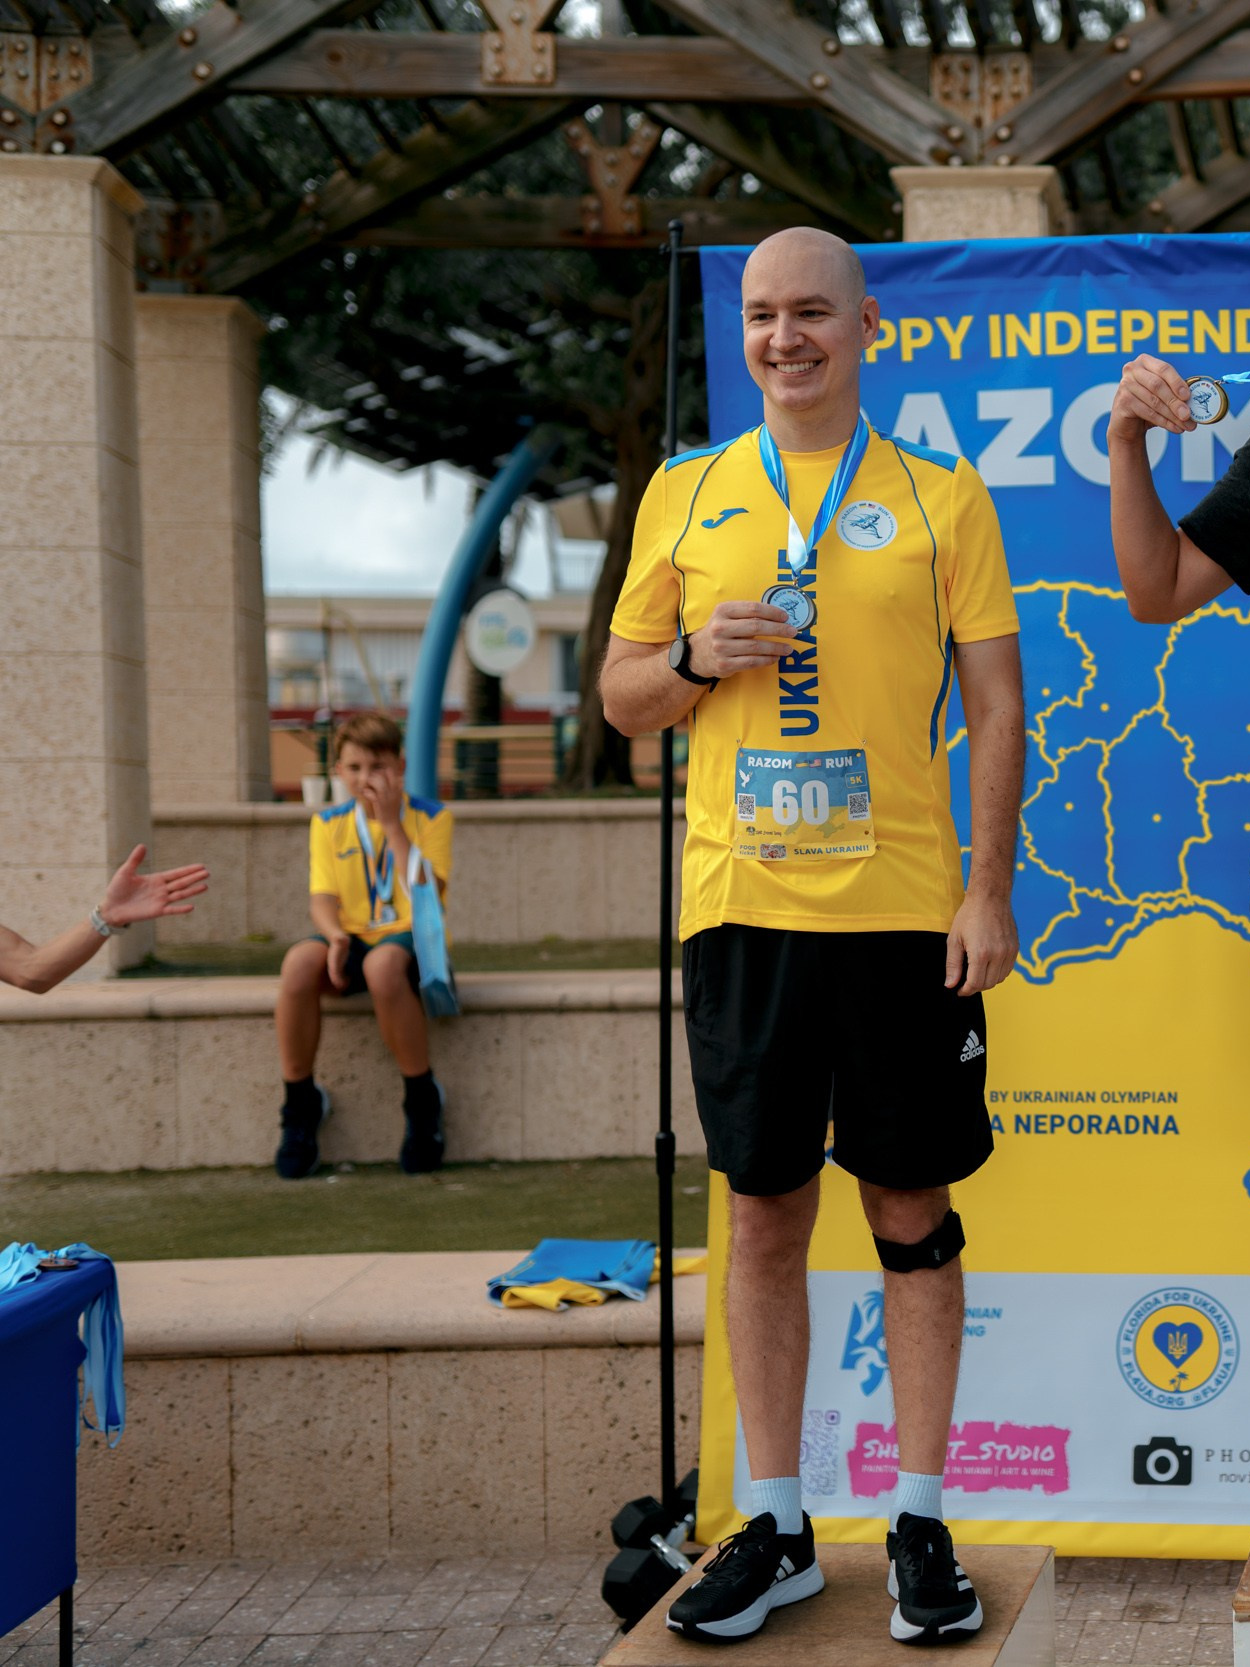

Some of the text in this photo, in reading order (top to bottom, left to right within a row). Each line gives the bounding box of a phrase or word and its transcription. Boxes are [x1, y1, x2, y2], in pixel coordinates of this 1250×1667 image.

[862, 316, 973, 363] PPY
[777, 549, 820, 737] UKRE
[747, 756, 853, 769] RAZOM RUN
[849, 775, 863, 785] 5K
[772, 779, 830, 826] 60
[794, 847, 823, 855] SLAVA
[960, 1044, 985, 1063] adidas
[989, 1091, 1178, 1104] BY UKRAINIAN OLYMPIAN
[1013, 1114, 1180, 1135] NEPORADNA
[1123, 1291, 1233, 1343] FLORIDA FOR UKRAINE
